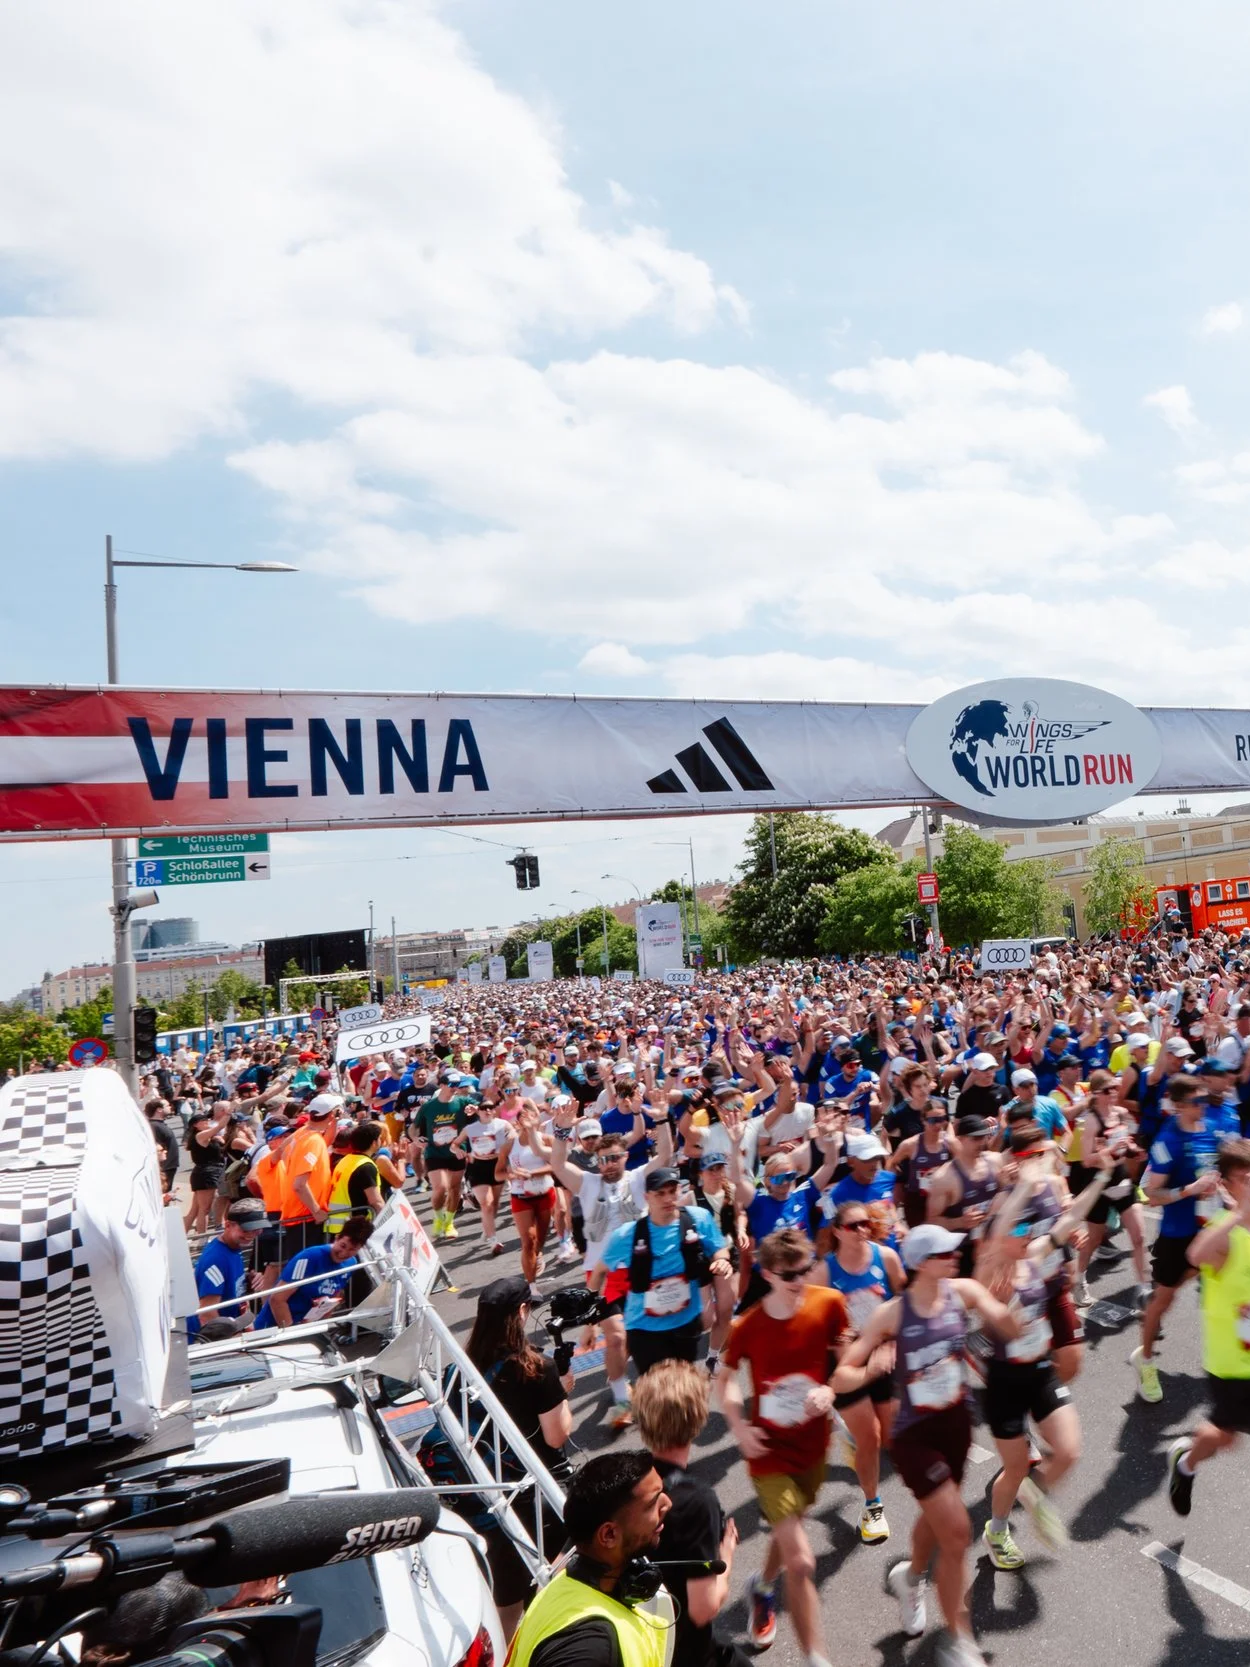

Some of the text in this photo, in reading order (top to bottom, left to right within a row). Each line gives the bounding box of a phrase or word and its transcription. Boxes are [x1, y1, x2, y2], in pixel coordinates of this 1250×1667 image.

[1019, 739, 1056, 754] LIFE
[127, 716, 490, 801] VIENNA
[189, 843, 245, 853] Museum
[168, 859, 240, 872] Schloßallee
[168, 871, 241, 883] Schönbrunn
[340, 1515, 422, 1551] SEITEN
